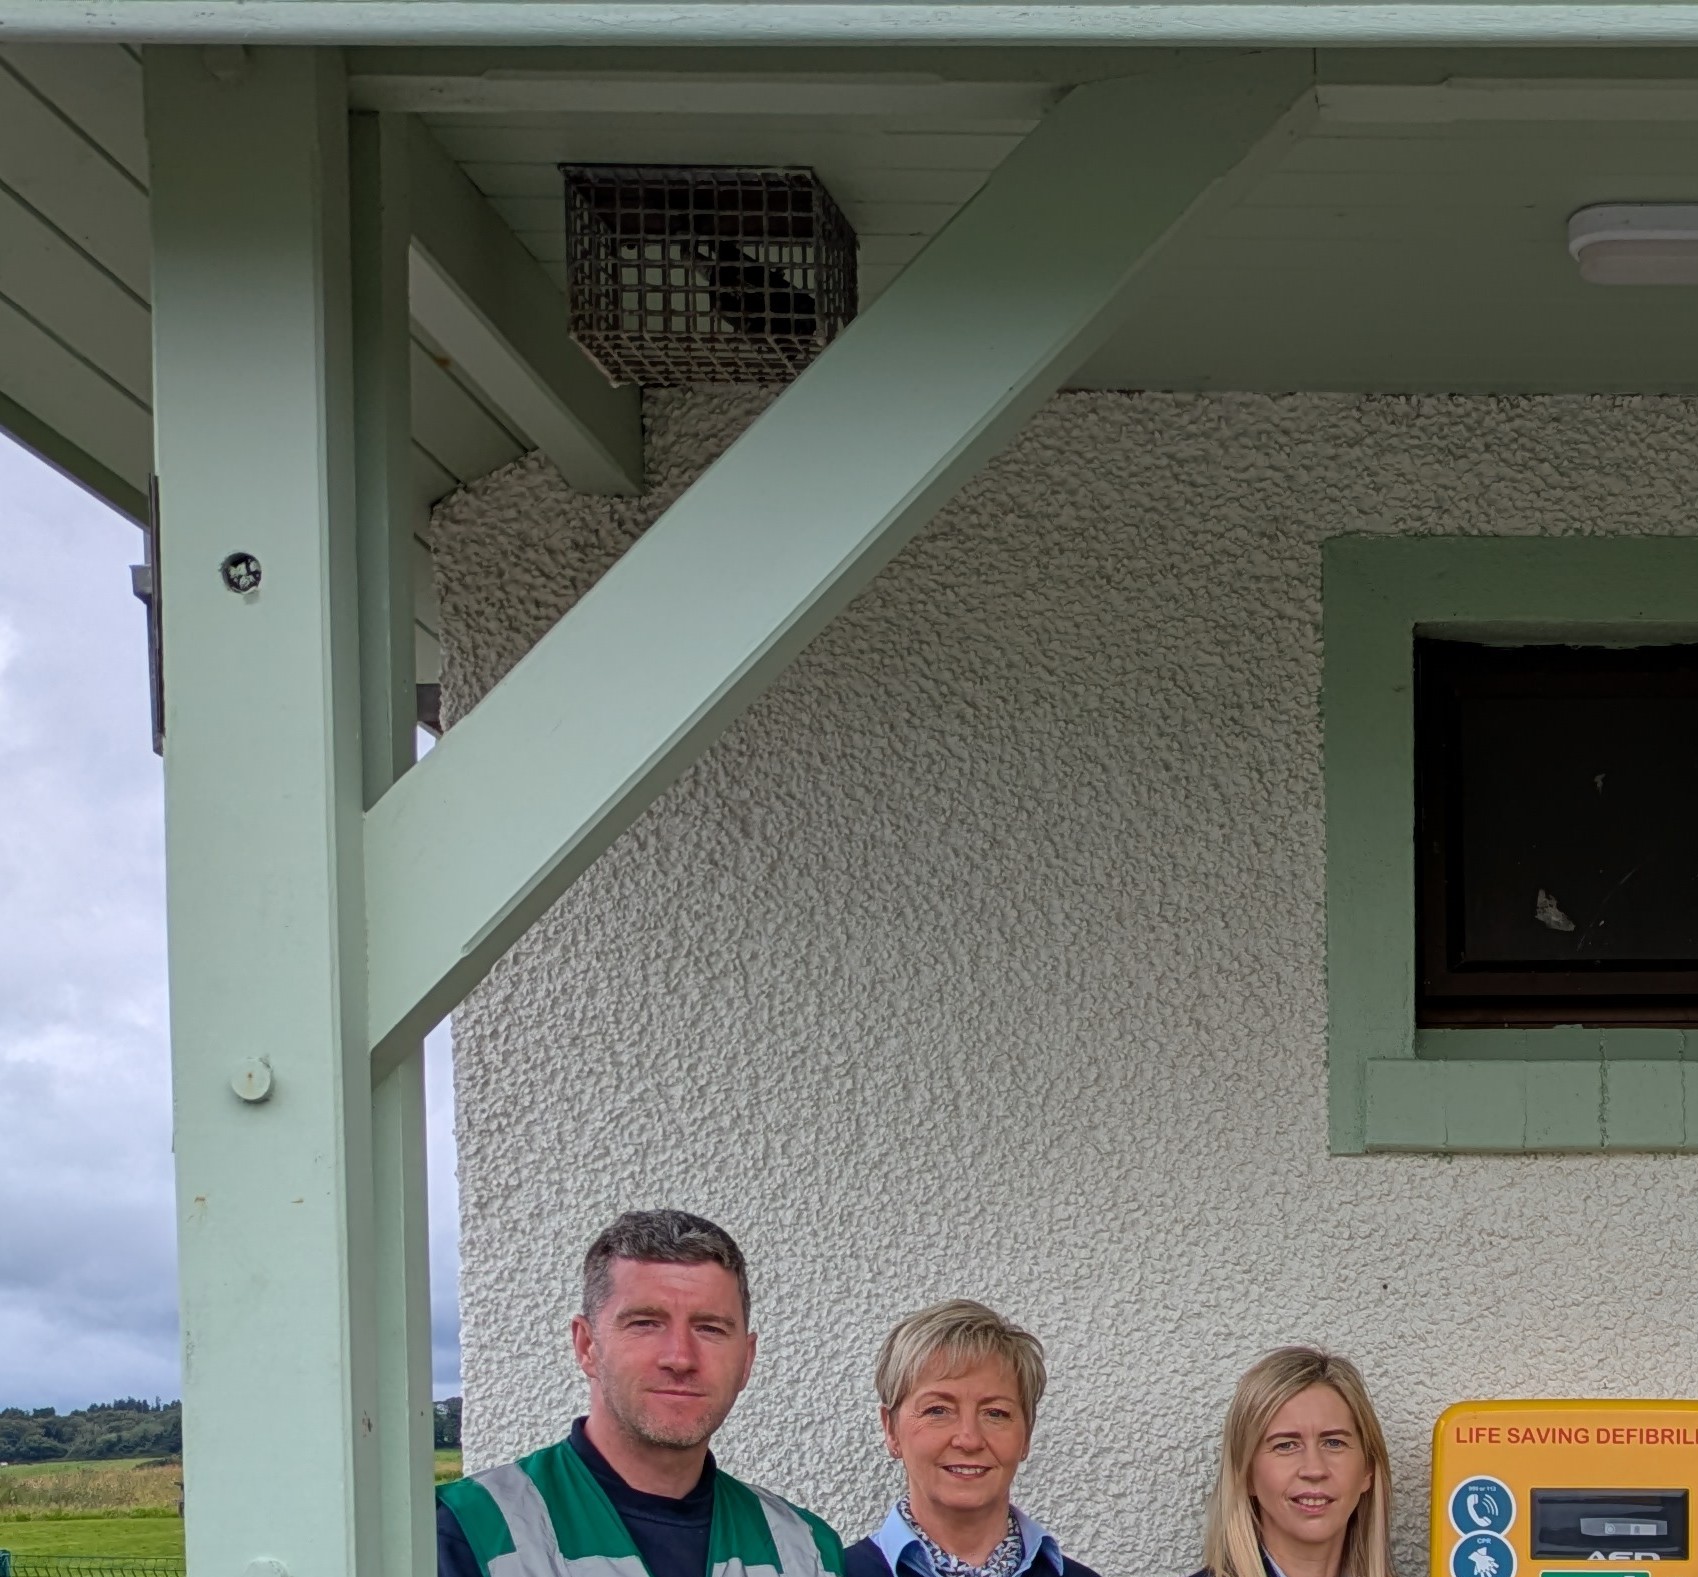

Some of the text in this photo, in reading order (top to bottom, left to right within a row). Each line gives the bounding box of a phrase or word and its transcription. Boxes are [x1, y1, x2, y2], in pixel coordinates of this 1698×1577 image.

[1455, 1426, 1501, 1444] LIFE
[1507, 1427, 1590, 1445] SAVING
[1476, 1537, 1492, 1545] CPR
